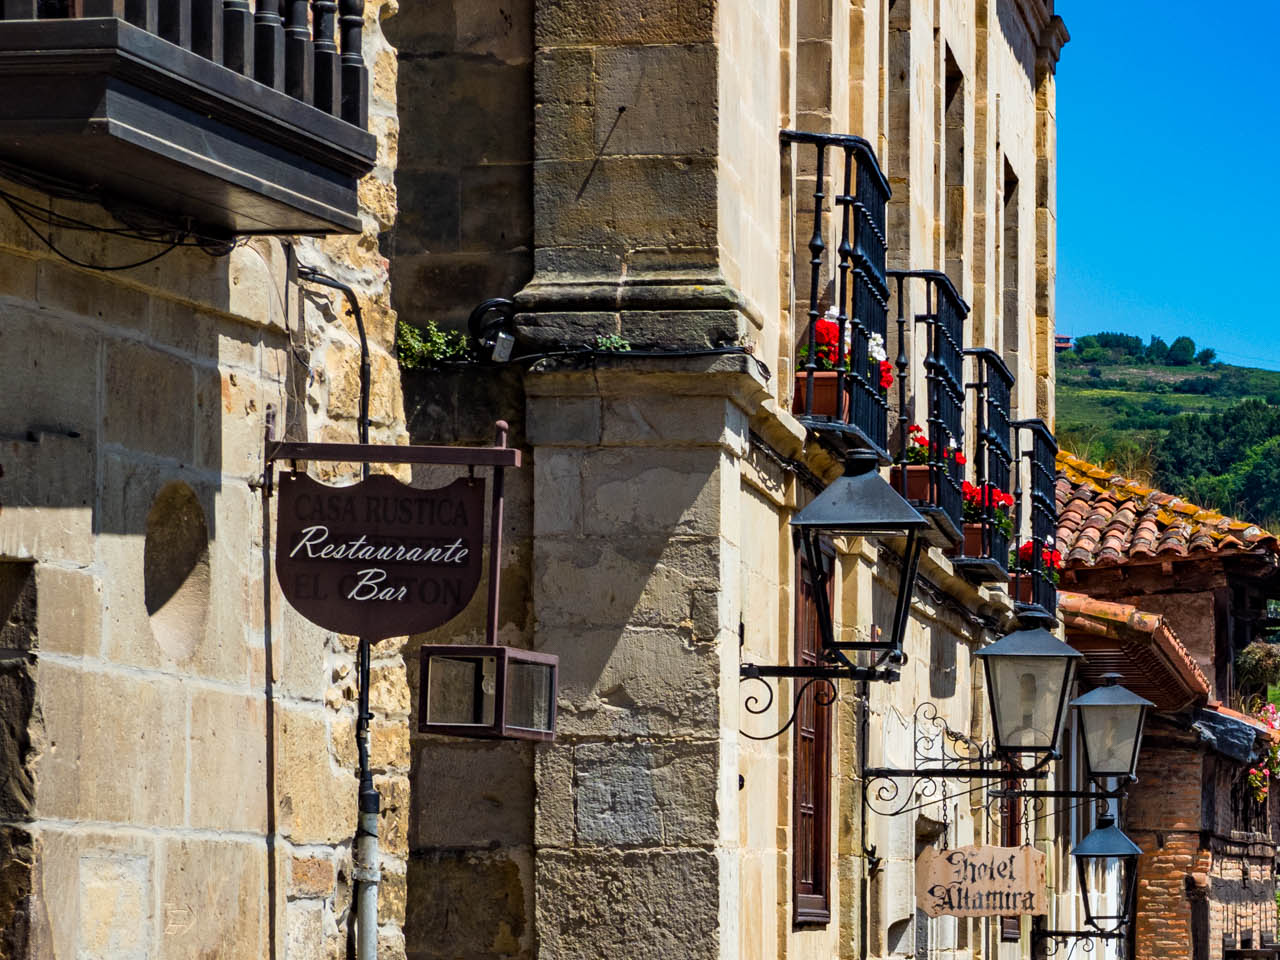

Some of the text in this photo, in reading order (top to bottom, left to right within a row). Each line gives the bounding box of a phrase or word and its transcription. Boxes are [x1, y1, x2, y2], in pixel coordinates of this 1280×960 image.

[294, 493, 468, 527] CASA RUSTICA
[289, 525, 469, 564] Restaurante
[347, 568, 409, 602] Bar
[946, 851, 1017, 885] Hotel
[927, 884, 1036, 912] Altamira
